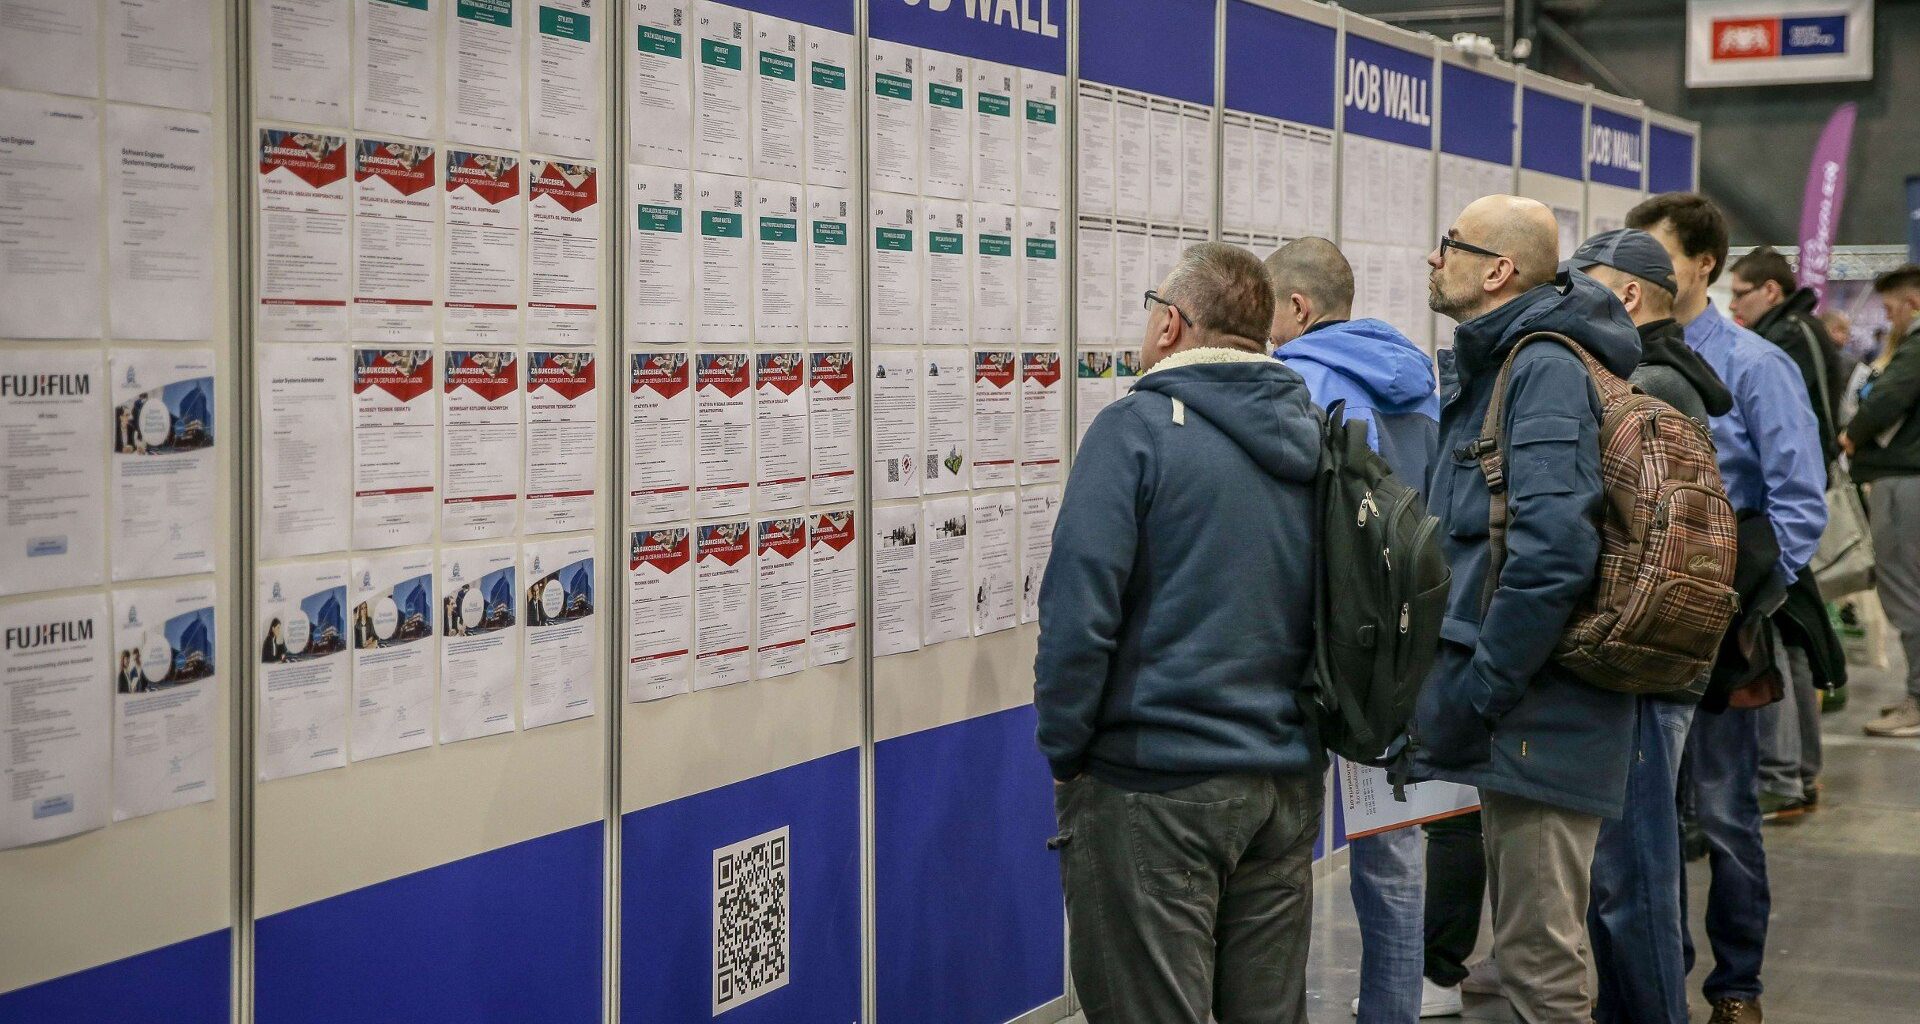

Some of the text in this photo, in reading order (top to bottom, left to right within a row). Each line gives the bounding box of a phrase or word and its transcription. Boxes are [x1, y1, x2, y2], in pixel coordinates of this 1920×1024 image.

[700, 18, 709, 26] LPP
[1345, 57, 1430, 126] JOB WALL
[10, 136, 35, 146] Engineer
[122, 148, 144, 156] Software
[1612, 127, 1642, 172] WALL
[1, 374, 90, 397] FUJIFILM
[5, 618, 93, 650] FUJIFILM
